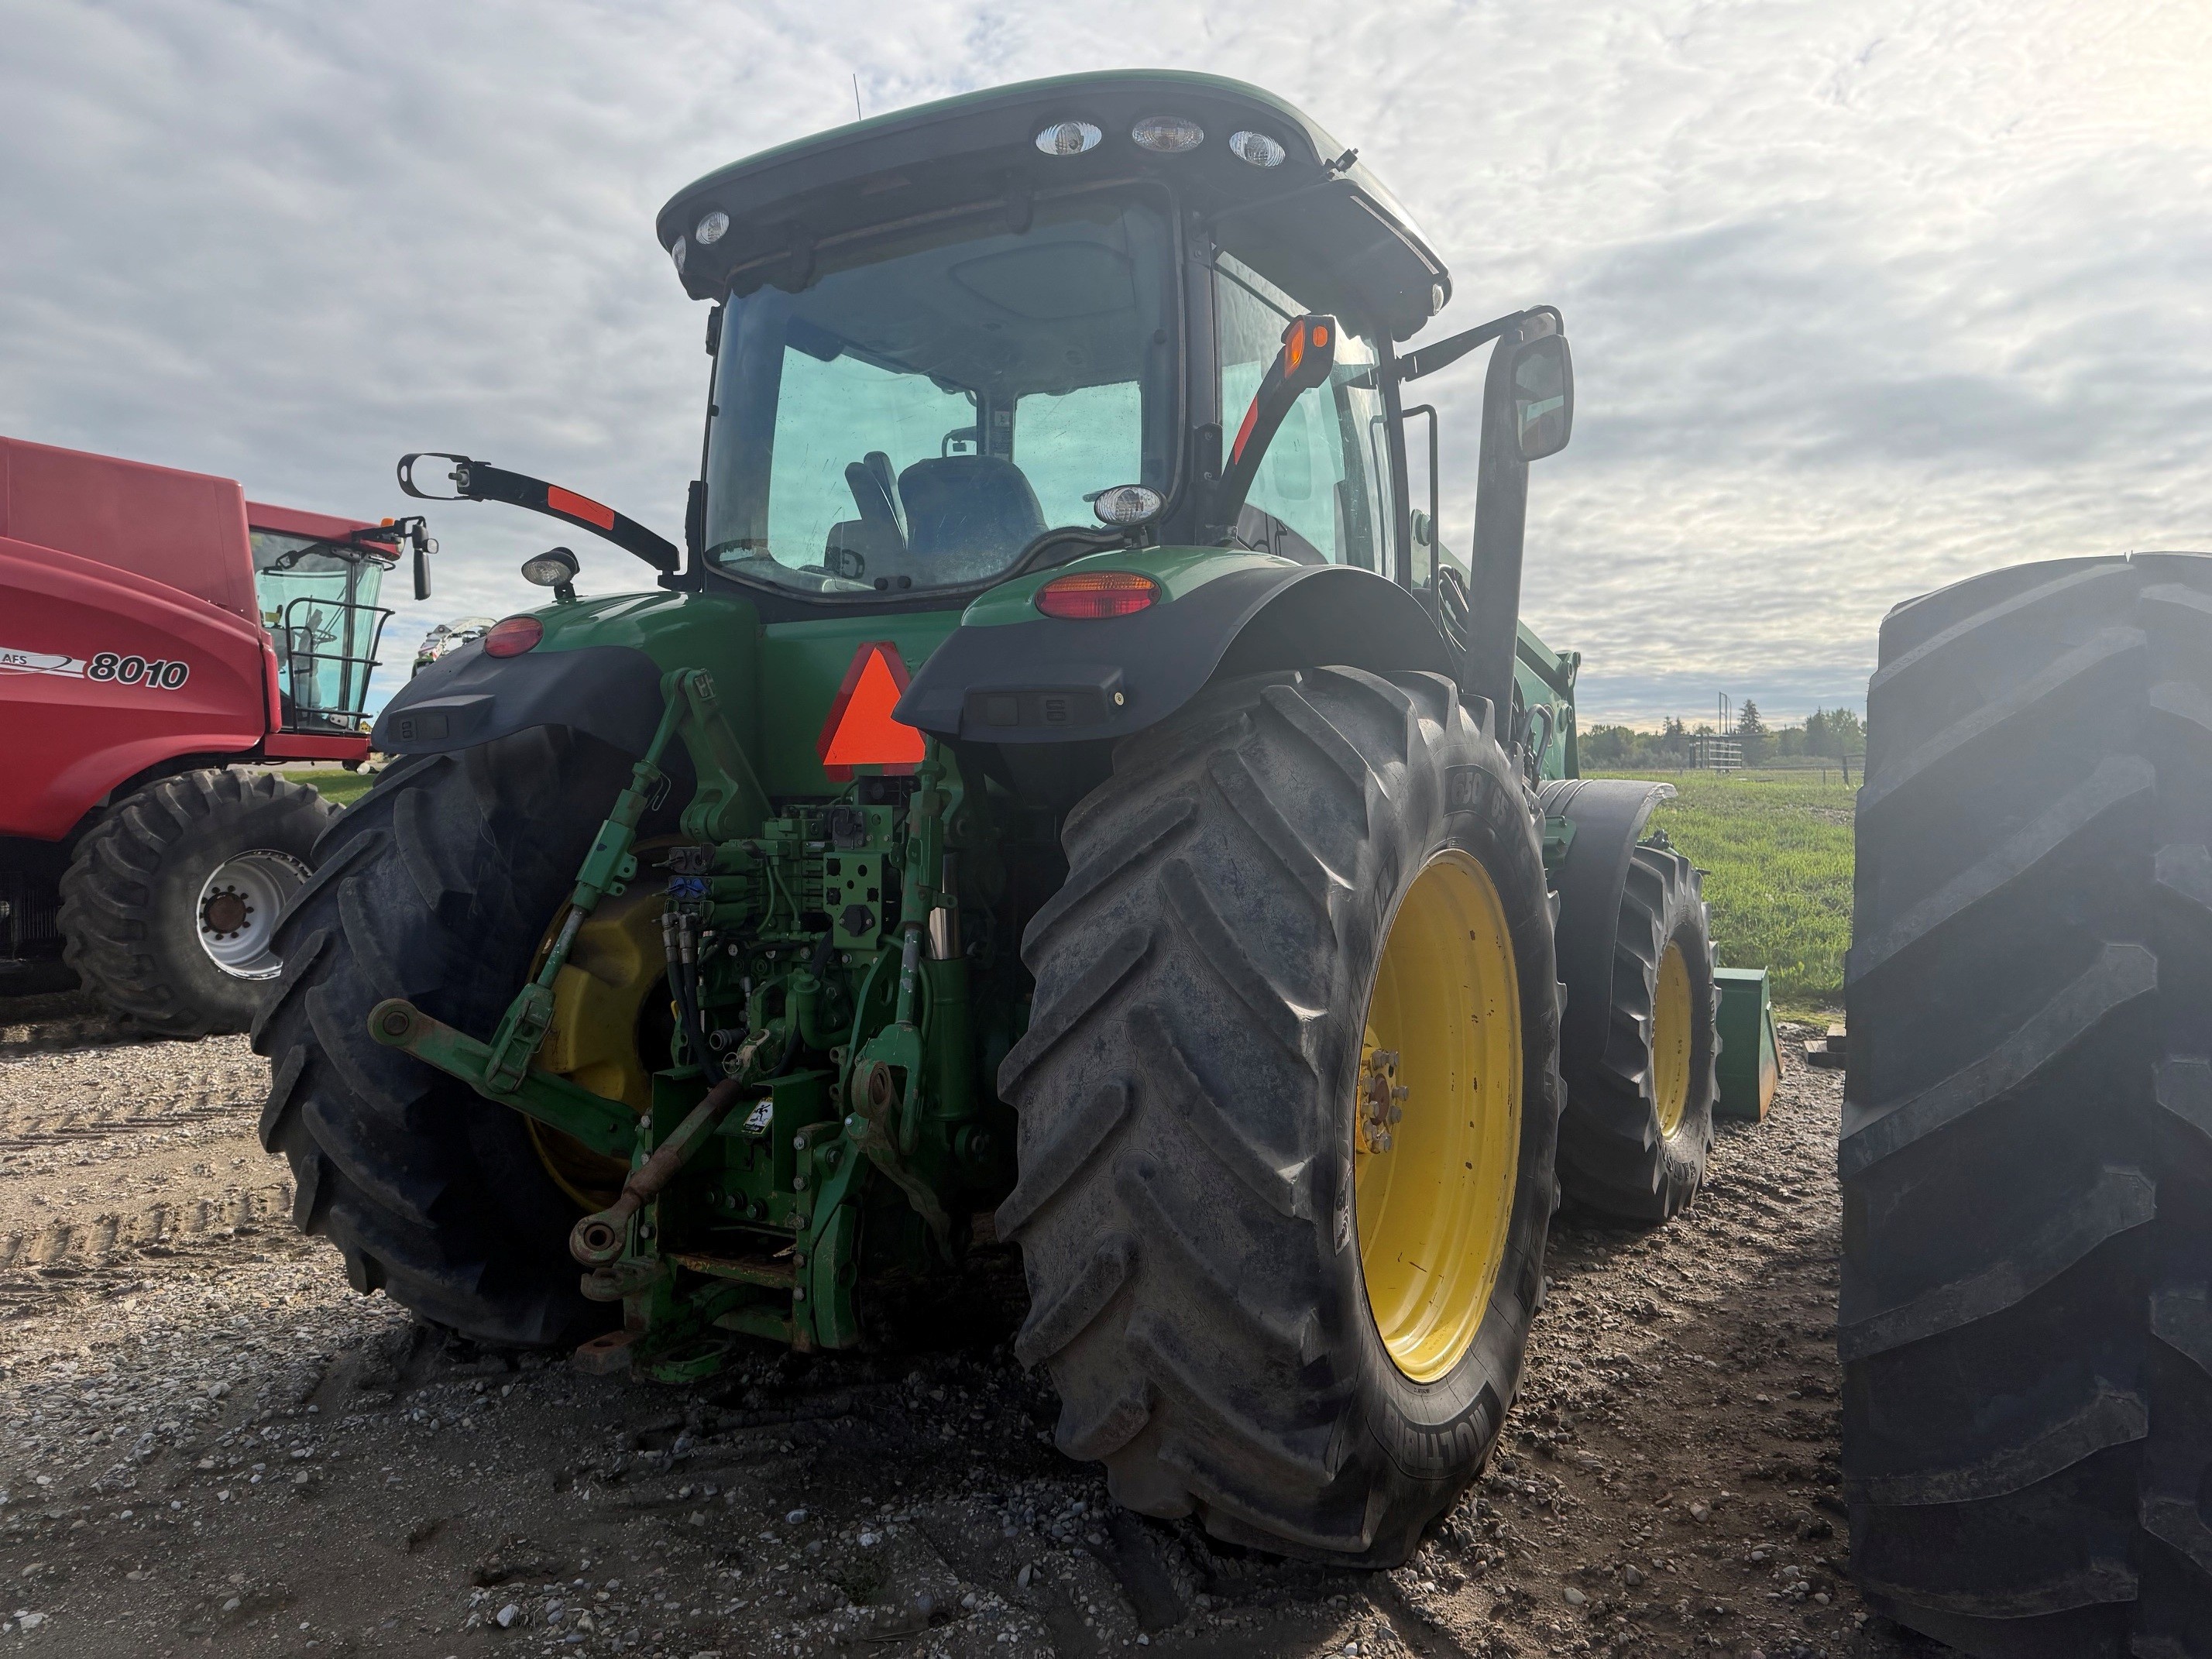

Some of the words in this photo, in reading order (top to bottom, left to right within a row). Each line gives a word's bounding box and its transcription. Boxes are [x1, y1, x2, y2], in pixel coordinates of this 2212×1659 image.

[2, 653, 27, 665] AFS
[88, 653, 189, 689] 8010
[1382, 1403, 1492, 1470] MULTIBIB
